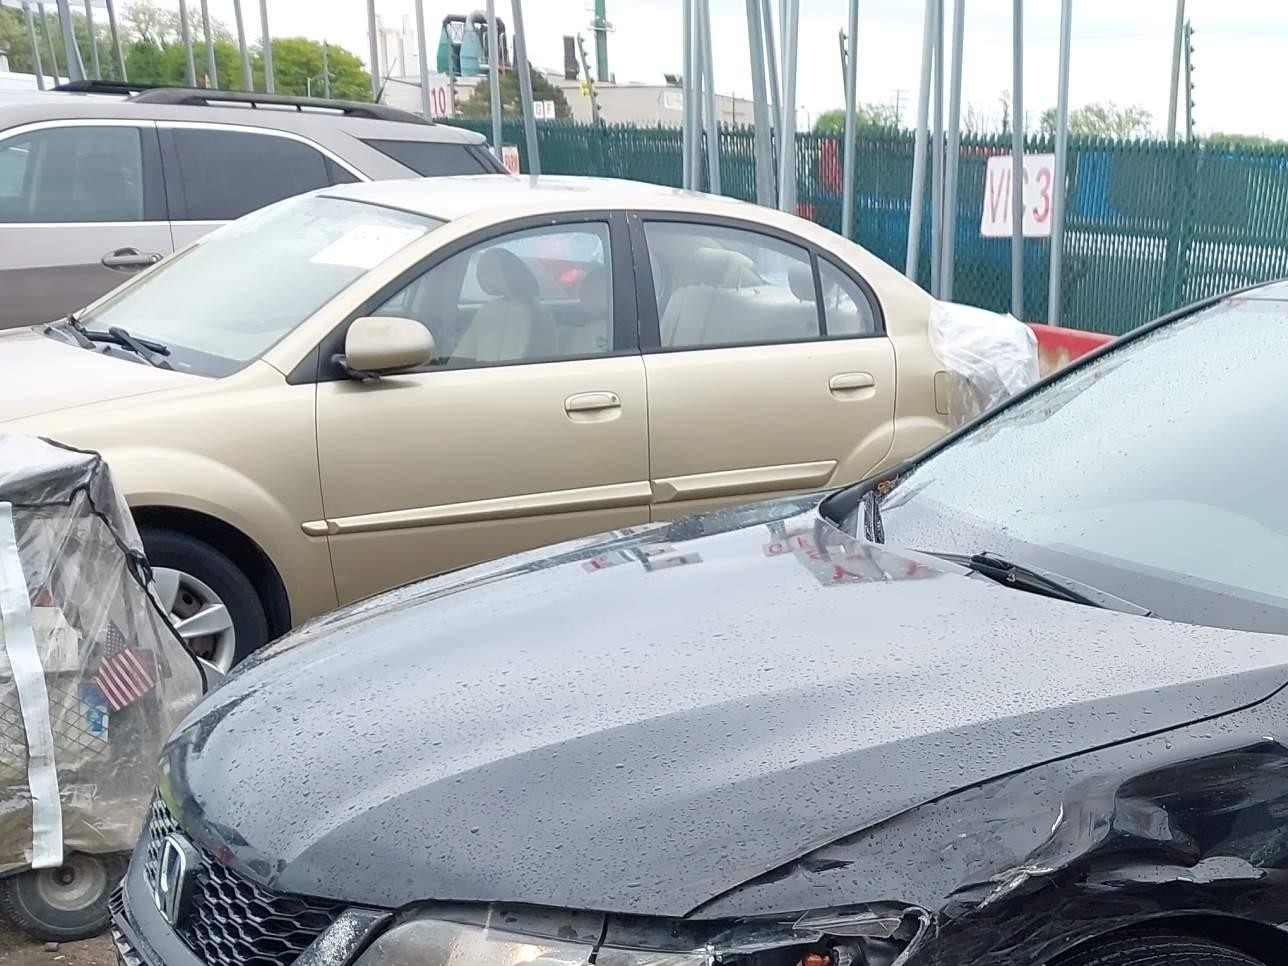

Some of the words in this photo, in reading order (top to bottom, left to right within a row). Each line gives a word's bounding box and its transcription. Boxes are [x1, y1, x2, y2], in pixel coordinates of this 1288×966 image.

[432, 86, 447, 115] 10
[990, 167, 1029, 224] VI
[1033, 166, 1051, 223] 3
